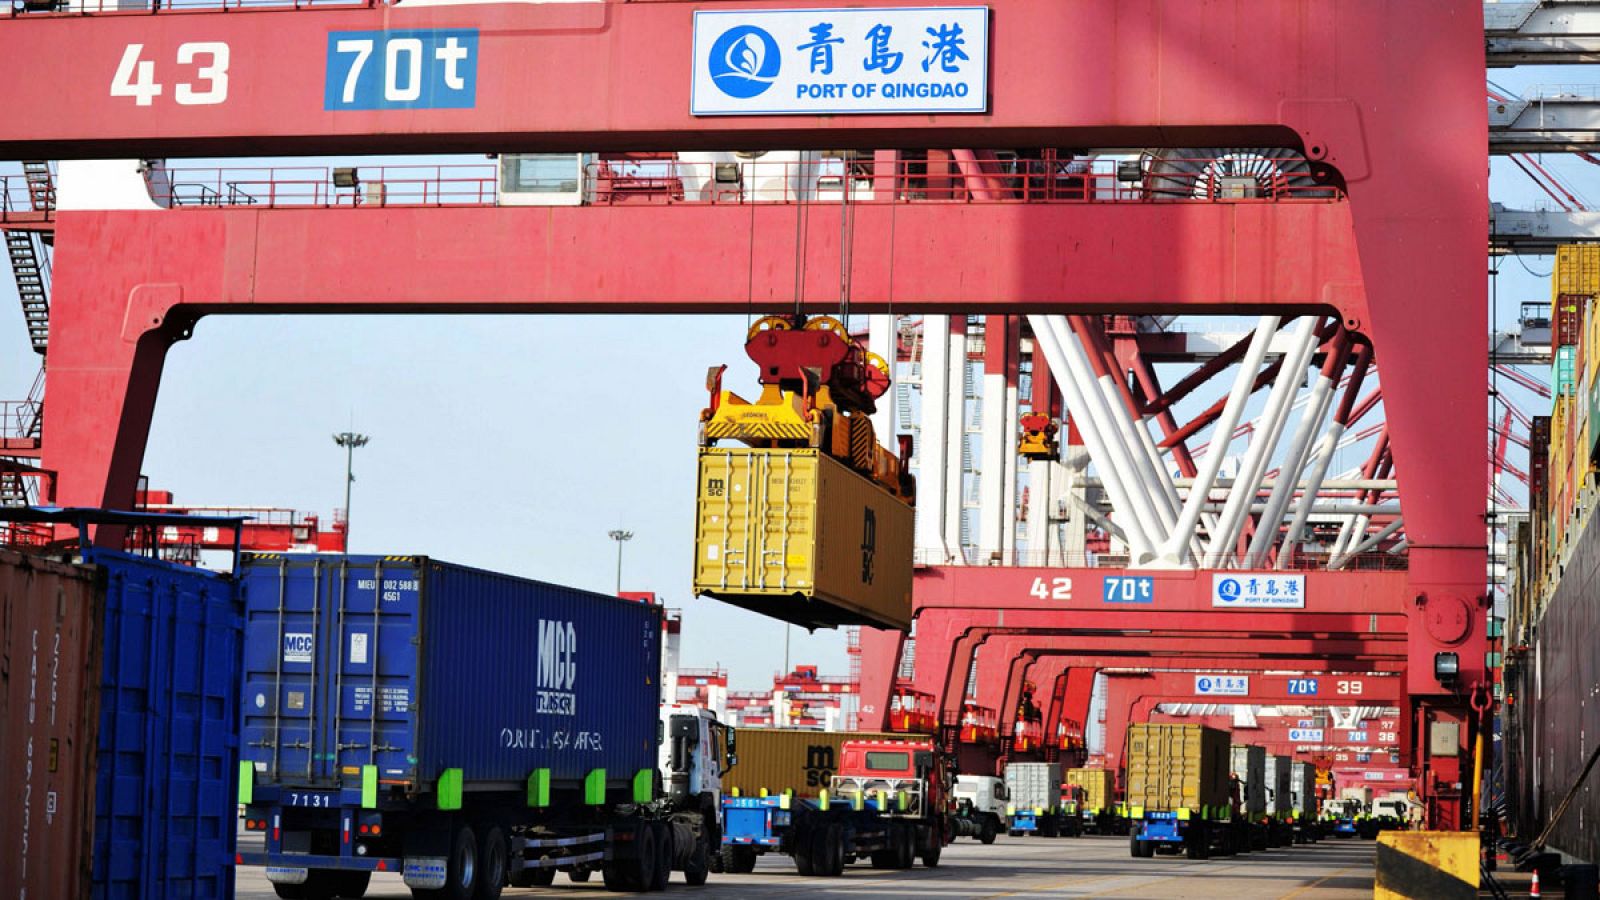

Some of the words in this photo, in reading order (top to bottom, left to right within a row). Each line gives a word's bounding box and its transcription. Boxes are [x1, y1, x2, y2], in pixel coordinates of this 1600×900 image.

[109, 42, 230, 106] 43
[336, 38, 467, 103] 70t
[797, 83, 847, 99] PORT
[852, 83, 876, 98] OF
[882, 82, 969, 99] QINGDAO
[1030, 577, 1073, 600] 42
[1106, 579, 1150, 601] 70t
[284, 636, 312, 652] MCC
[536, 619, 577, 690] MCC
[1289, 680, 1316, 694] 70t
[1337, 681, 1363, 694] 39
[291, 793, 329, 808] 7131
